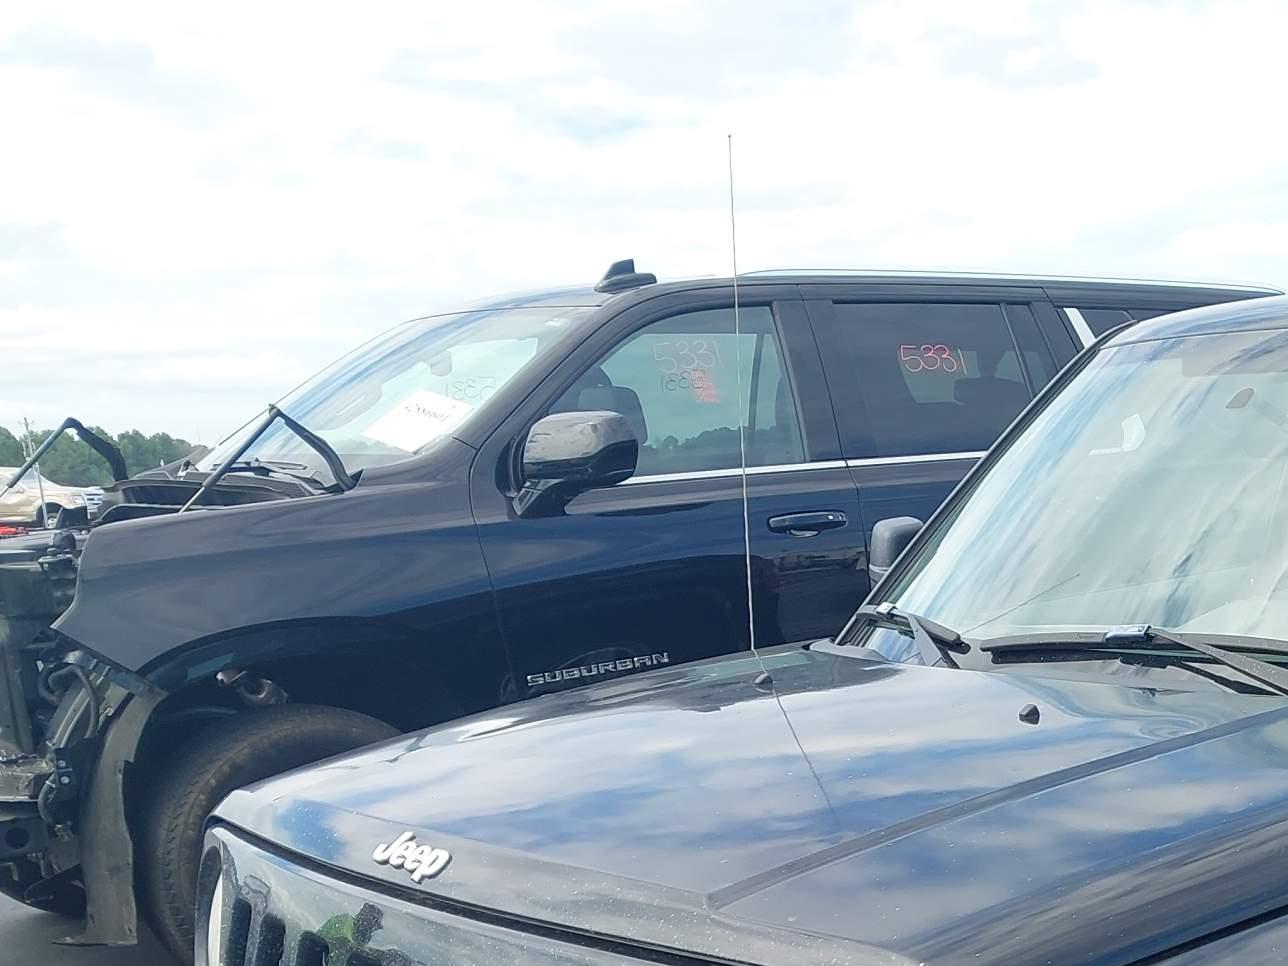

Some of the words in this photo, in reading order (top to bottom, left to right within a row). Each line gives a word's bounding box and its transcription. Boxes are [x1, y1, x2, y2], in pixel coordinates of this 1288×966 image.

[899, 343, 967, 377] 5331
[526, 652, 669, 687] SUBURBAN
[372, 831, 452, 884] Jeep
